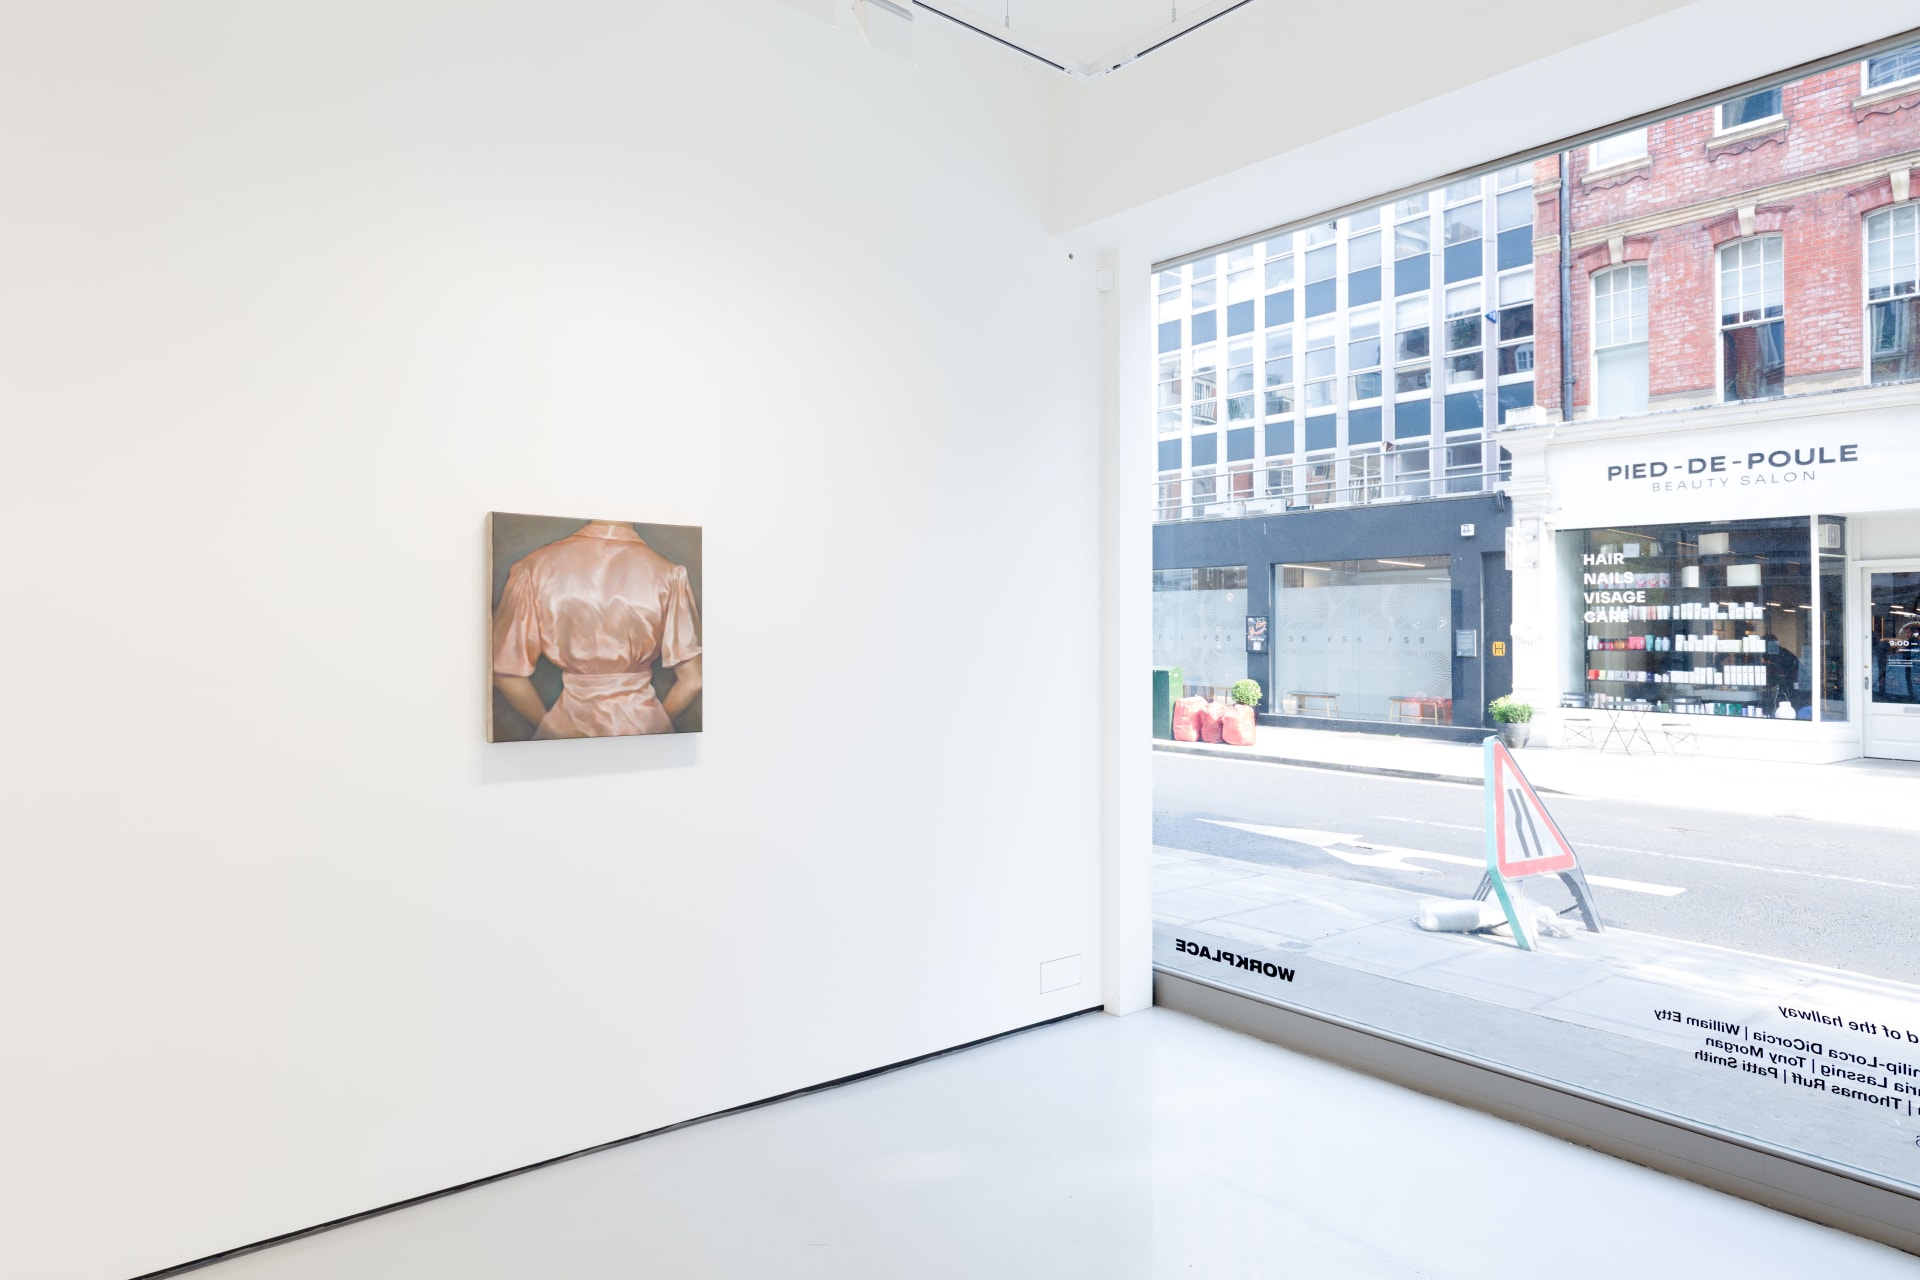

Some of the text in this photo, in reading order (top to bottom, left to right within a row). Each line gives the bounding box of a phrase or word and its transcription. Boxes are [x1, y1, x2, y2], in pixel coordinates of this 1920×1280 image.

[1653, 471, 1815, 492] BEAUTY SALON
[1583, 552, 1625, 566] HAIR
[1583, 571, 1634, 585] NAILS
[1583, 590, 1646, 604] VISAGE
[1583, 610, 1629, 623] CARE
